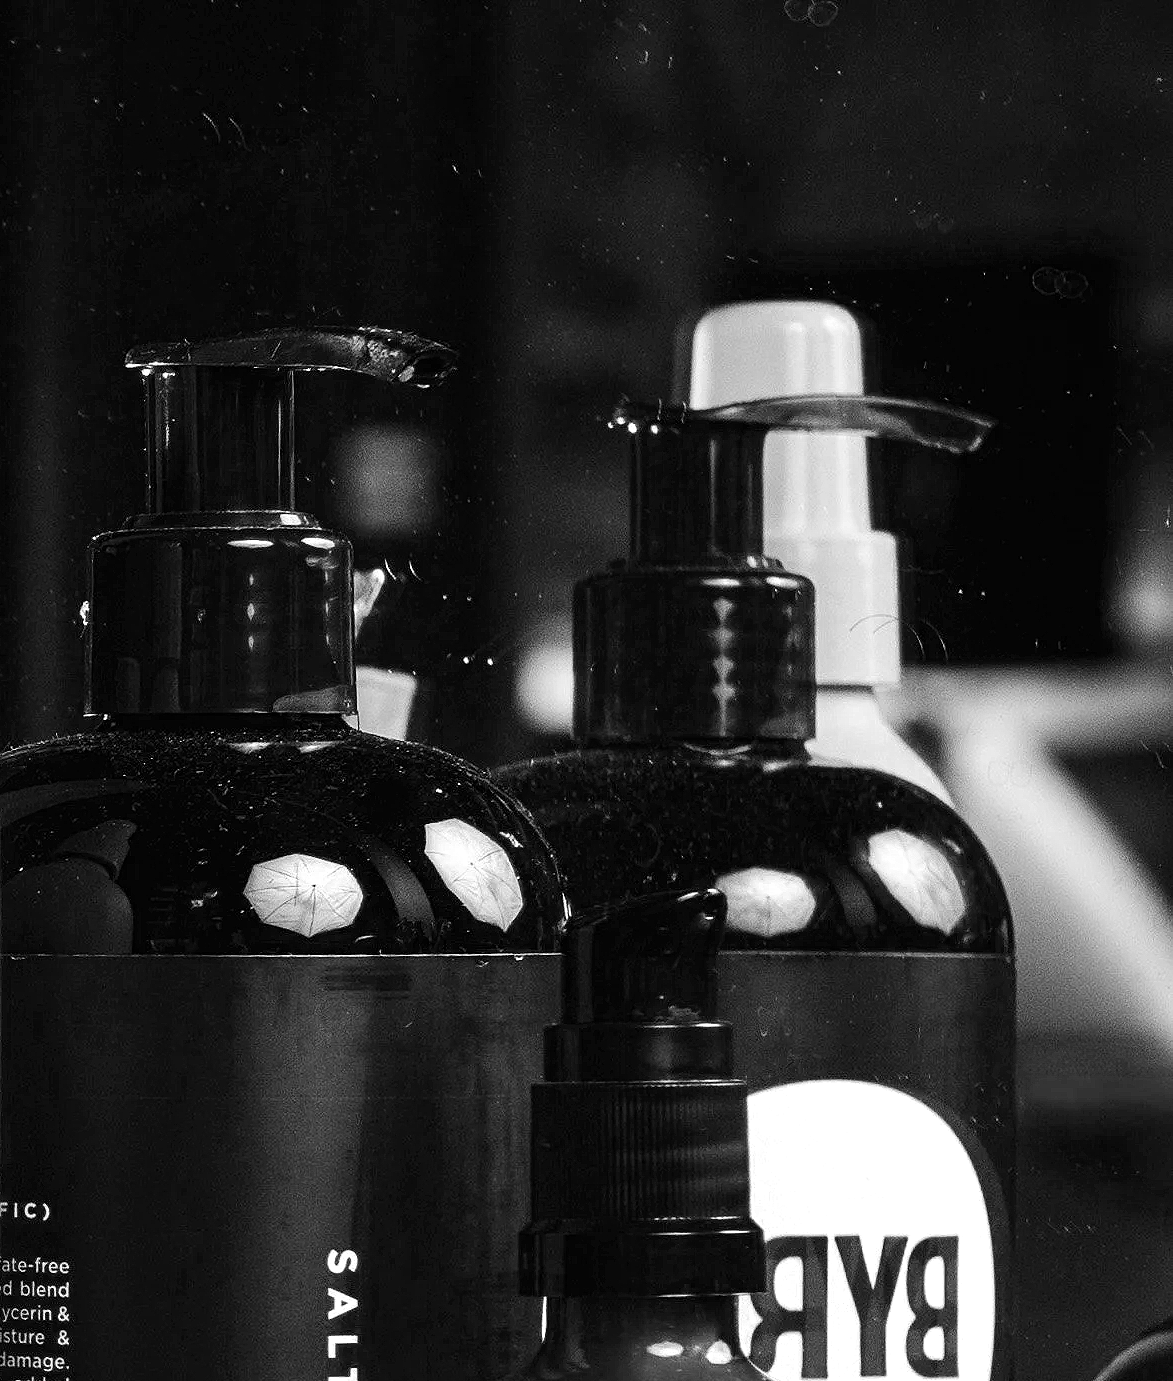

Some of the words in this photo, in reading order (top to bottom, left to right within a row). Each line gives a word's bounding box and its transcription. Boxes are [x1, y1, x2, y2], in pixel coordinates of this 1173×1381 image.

[20, 1281, 70, 1298] blend
[58, 1306, 70, 1322] &
[58, 1329, 70, 1346] &
